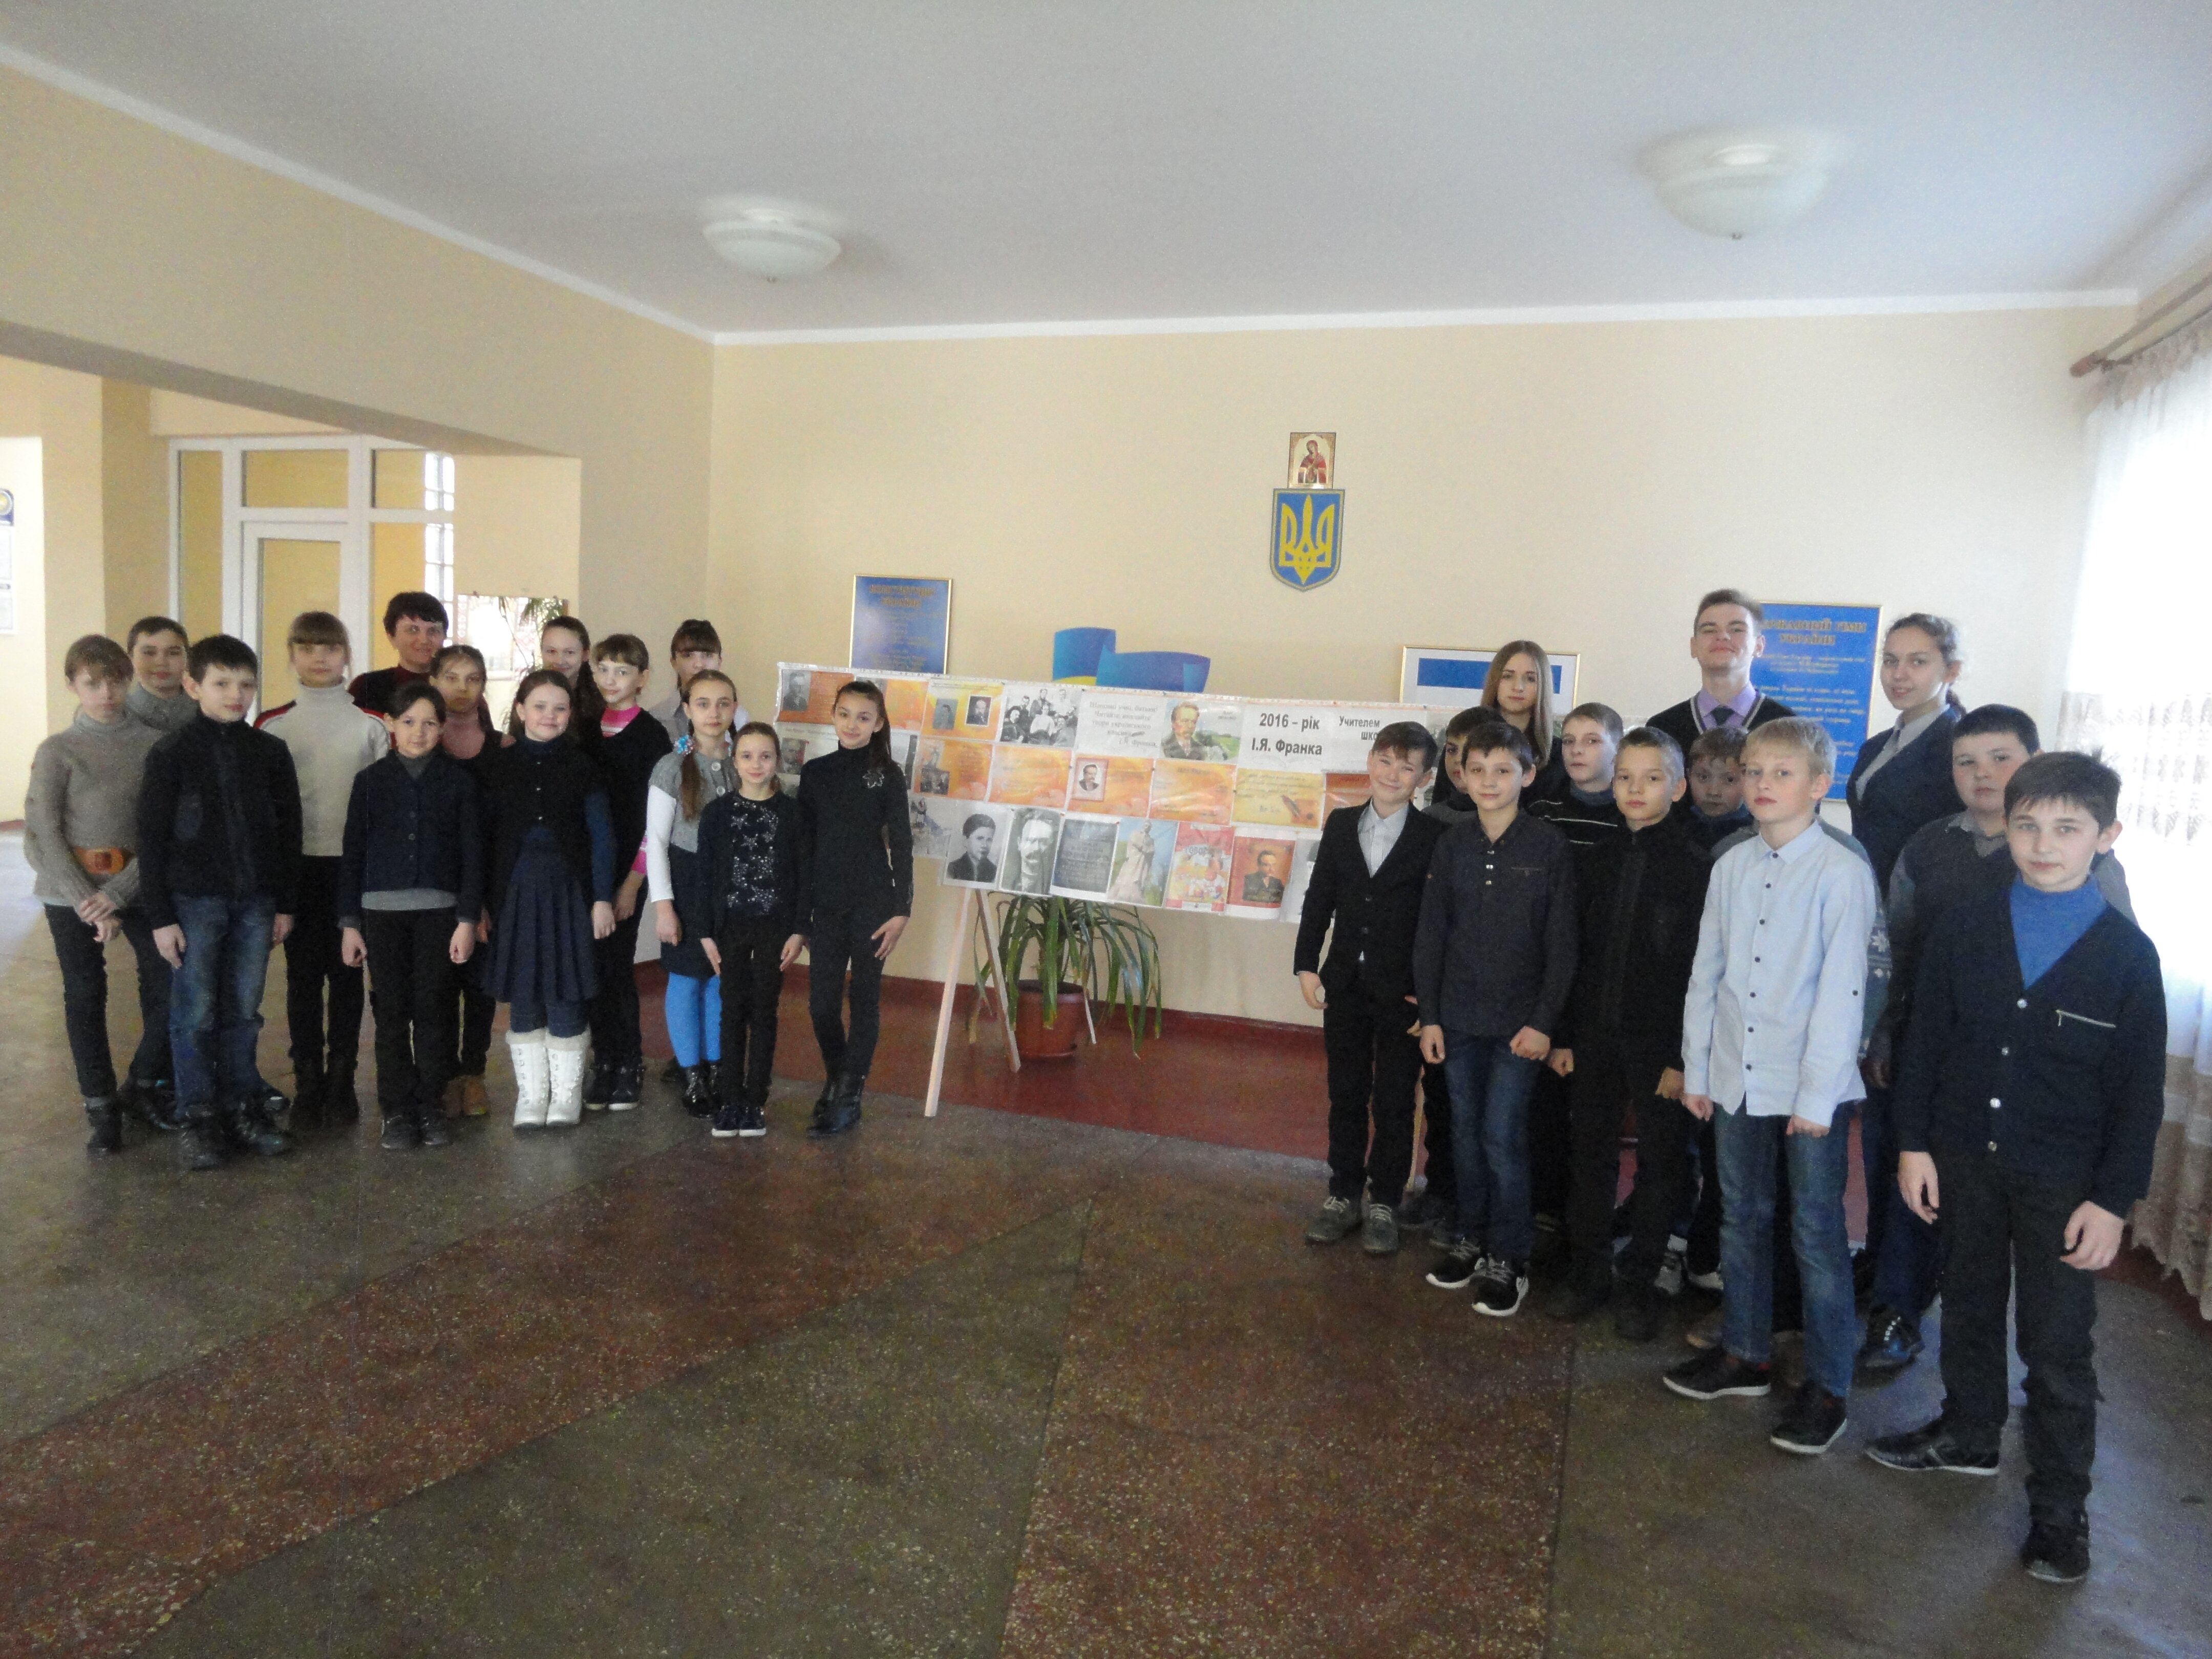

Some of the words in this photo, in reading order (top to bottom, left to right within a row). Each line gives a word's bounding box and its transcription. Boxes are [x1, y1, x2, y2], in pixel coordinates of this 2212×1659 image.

[1260, 713, 1289, 728] 2016
[1301, 715, 1320, 732] рік
[1339, 715, 1380, 727] Учителем
[1361, 732, 1378, 740] шко
[1252, 737, 1271, 751] І.Я.
[1275, 738, 1323, 756] Франка
